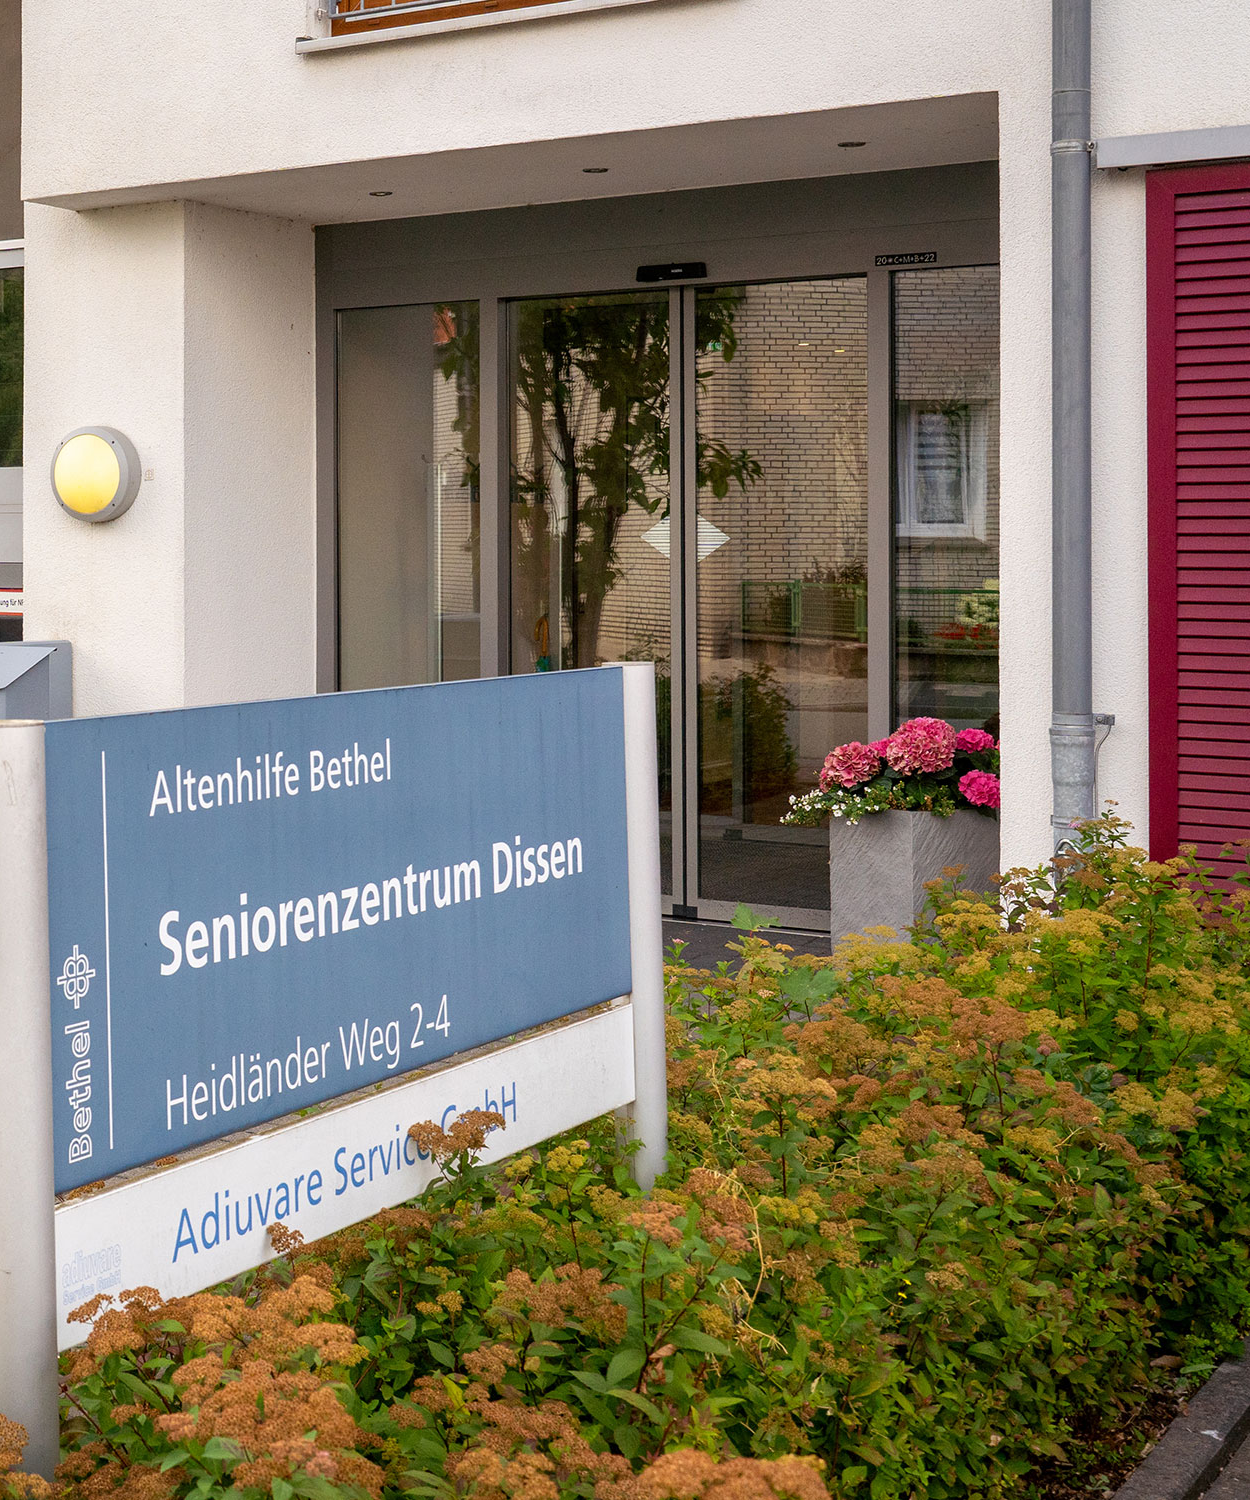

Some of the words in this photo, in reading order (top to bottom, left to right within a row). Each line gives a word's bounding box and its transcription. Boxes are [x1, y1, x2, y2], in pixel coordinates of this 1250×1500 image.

[149, 751, 300, 817] Altenhilfe
[309, 737, 392, 792] Bethel
[158, 857, 482, 976] Seniorenzentrum
[492, 834, 583, 894] Dissen
[64, 1019, 93, 1164] Bethel
[166, 1035, 331, 1131] Heidländer
[338, 1017, 401, 1071] Weg
[410, 994, 451, 1049] 2-4
[172, 1169, 323, 1264] Adiuvare
